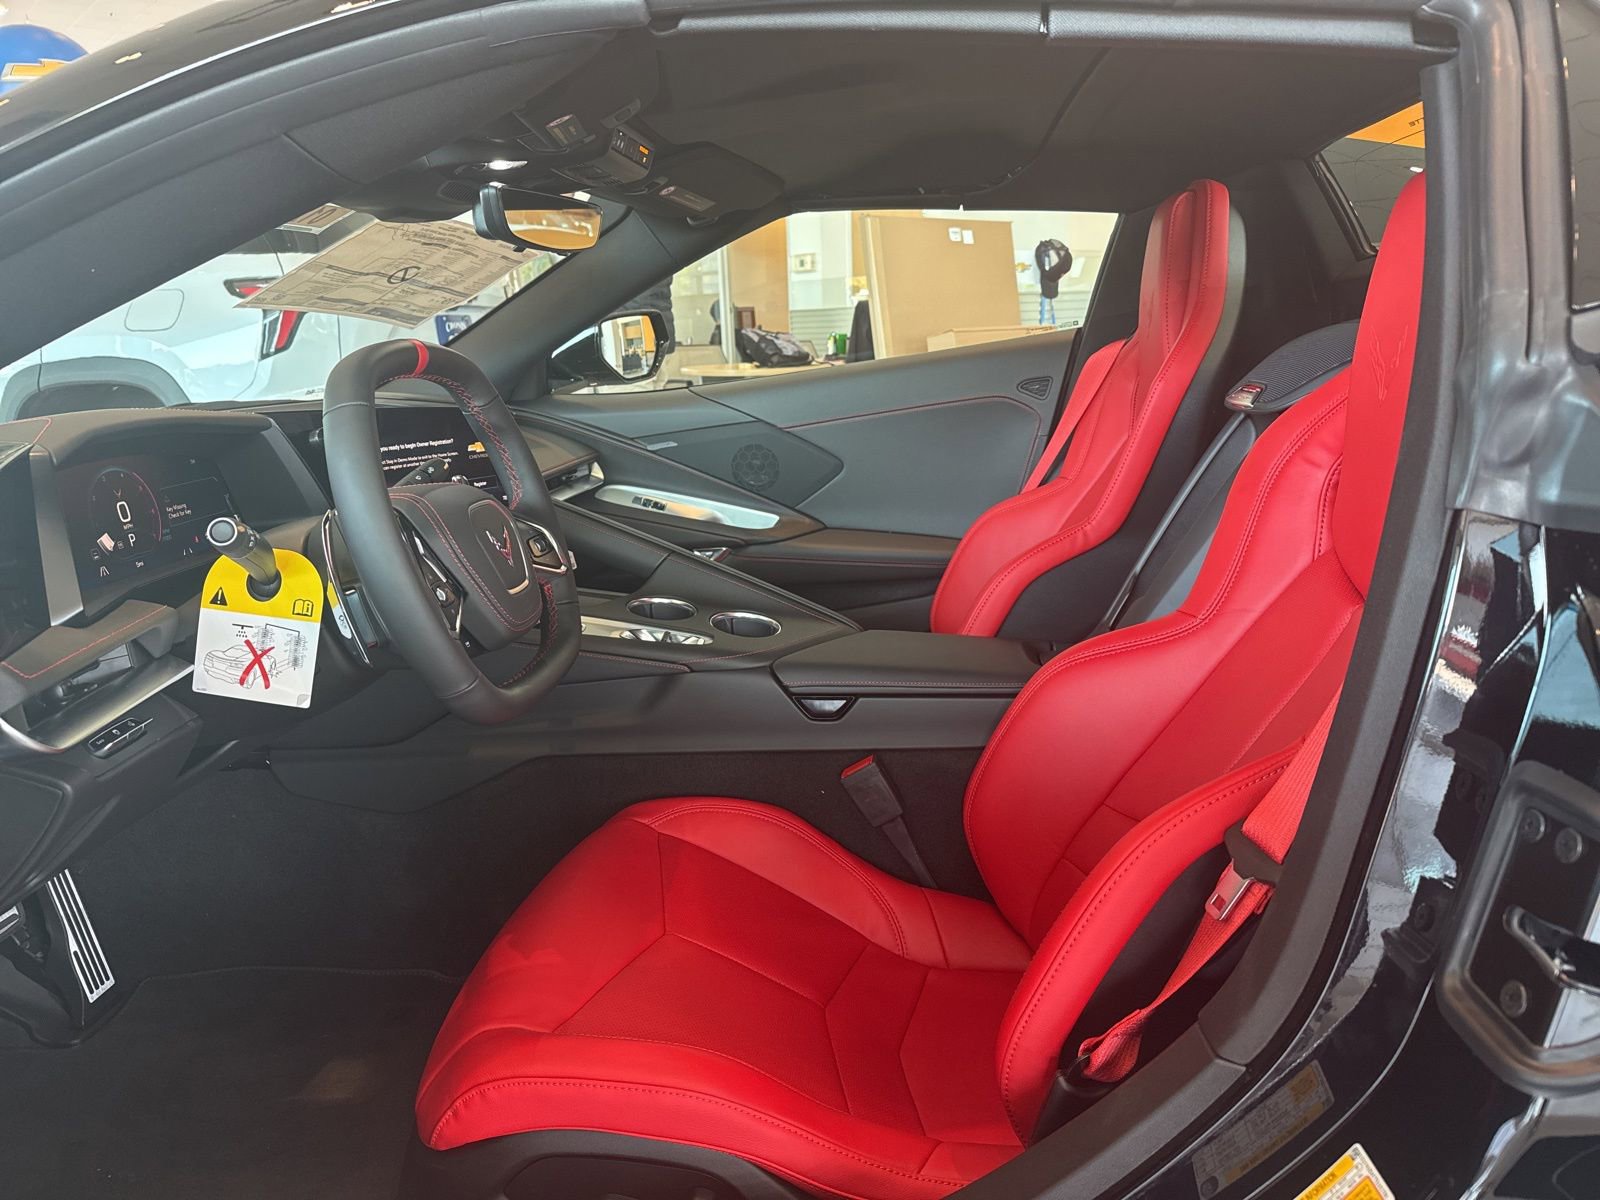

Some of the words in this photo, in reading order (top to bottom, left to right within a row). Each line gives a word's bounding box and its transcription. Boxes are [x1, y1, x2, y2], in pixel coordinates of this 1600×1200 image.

[429, 438, 454, 446] Registration?
[117, 501, 131, 522] 0
[128, 534, 136, 546] P
